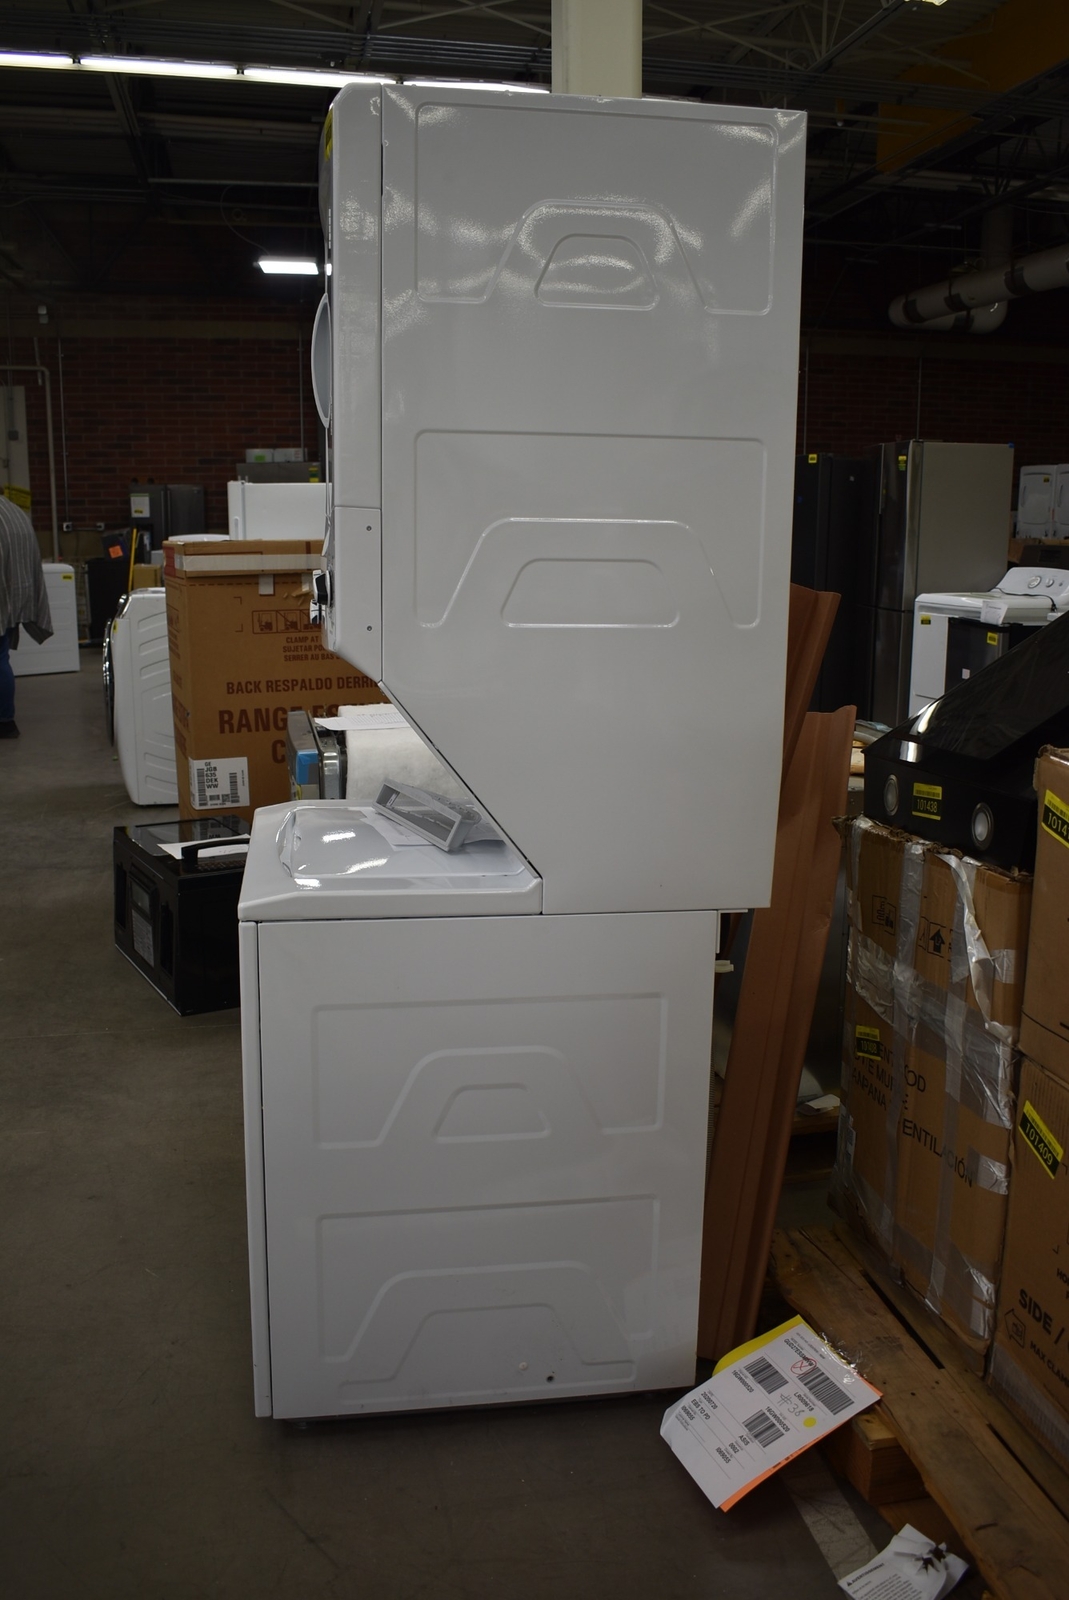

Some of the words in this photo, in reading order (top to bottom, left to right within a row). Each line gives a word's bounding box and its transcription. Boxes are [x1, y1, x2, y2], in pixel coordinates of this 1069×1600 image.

[282, 644, 313, 653] SUJETAR
[286, 635, 309, 644] CLAMP
[310, 635, 319, 643] AT
[283, 653, 309, 662] SERRER
[310, 653, 320, 661] AU
[226, 680, 262, 695] BACK
[266, 677, 333, 693] RESPALDO
[218, 705, 302, 734] RANG
[917, 799, 938, 813] 101438
[1047, 811, 1069, 841] 1014
[852, 1066, 887, 1111] AMPANA
[902, 1118, 972, 1188] ENTILACIÓN
[1025, 1122, 1054, 1166] 101409
[1018, 1288, 1053, 1336] SIDE
[1030, 1340, 1046, 1364] MAX
